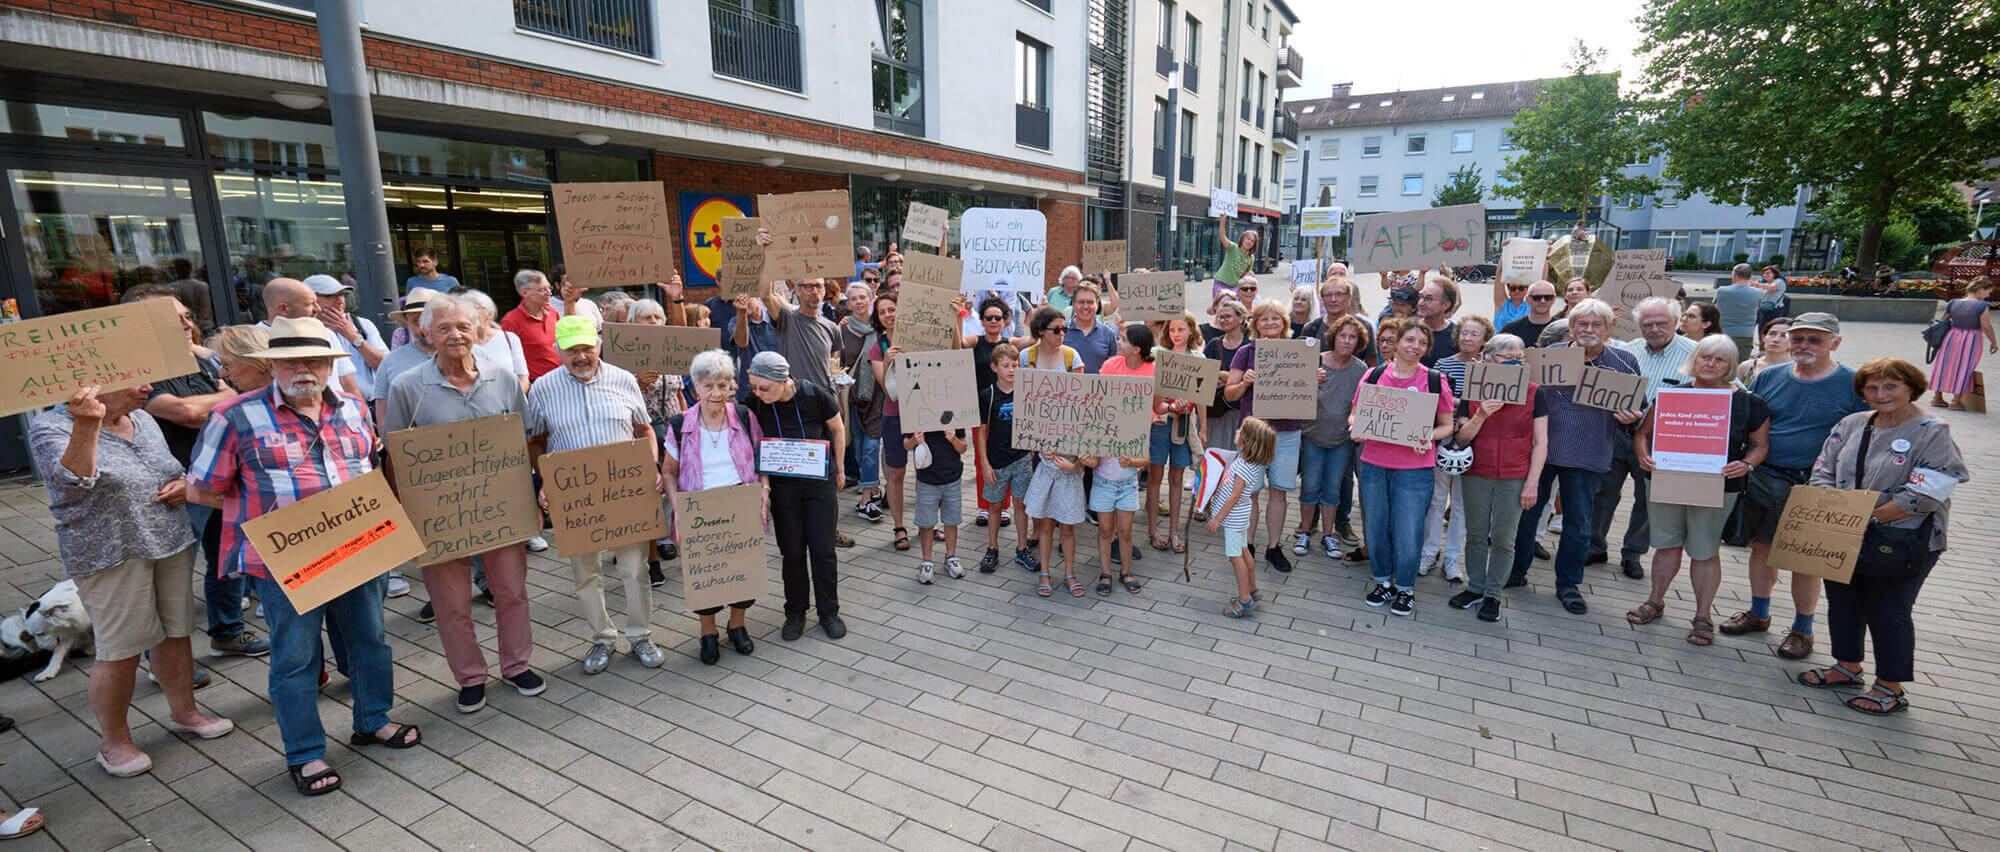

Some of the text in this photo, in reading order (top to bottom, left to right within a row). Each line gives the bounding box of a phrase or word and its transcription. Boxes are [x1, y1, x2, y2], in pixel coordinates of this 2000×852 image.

[1007, 218, 1023, 231] ein
[571, 239, 655, 255] Kein Mensch
[694, 224, 723, 251] Li
[725, 235, 758, 252] Stuttga
[963, 236, 1046, 253] VIELSEITIGES
[606, 253, 625, 264] ist
[971, 258, 1041, 277] BOTNANG
[909, 263, 945, 285] Vielfalt
[1615, 271, 1647, 281] EINER
[0, 315, 126, 348] REIHEIT
[608, 328, 652, 353] Kein
[3, 336, 105, 361] FREIHEIT
[635, 355, 690, 369] ist illeg
[1161, 354, 1202, 373] Wir sind
[1275, 360, 1307, 370] geboren
[1541, 353, 1567, 385] in
[1022, 373, 1154, 397] HAND IN HAND
[1160, 370, 1193, 390] BUNT
[1273, 378, 1290, 387] sind
[1468, 364, 1524, 403] Hand
[1576, 367, 1643, 411] Hand
[906, 376, 957, 407] ALLE
[1361, 385, 1409, 414] Liebe
[1023, 401, 1118, 422] IN BOTNANG
[1359, 407, 1395, 424] ist für
[1014, 417, 1035, 432] FÜR
[1362, 420, 1403, 440] ALLE
[402, 429, 493, 468] Soziale
[408, 448, 528, 491] Ungerechtigkeit
[554, 459, 644, 491] Gib Hass
[562, 484, 647, 513] und Hetze
[685, 497, 702, 513] In
[267, 496, 381, 554] Demokratie
[422, 500, 508, 538] rechtes
[565, 513, 608, 530] keine
[691, 513, 736, 530] Dresden!
[1783, 519, 1806, 531] GE
[427, 525, 516, 560] Denken
[687, 536, 765, 560] im Stuttgarter
[689, 561, 729, 576] Westen
